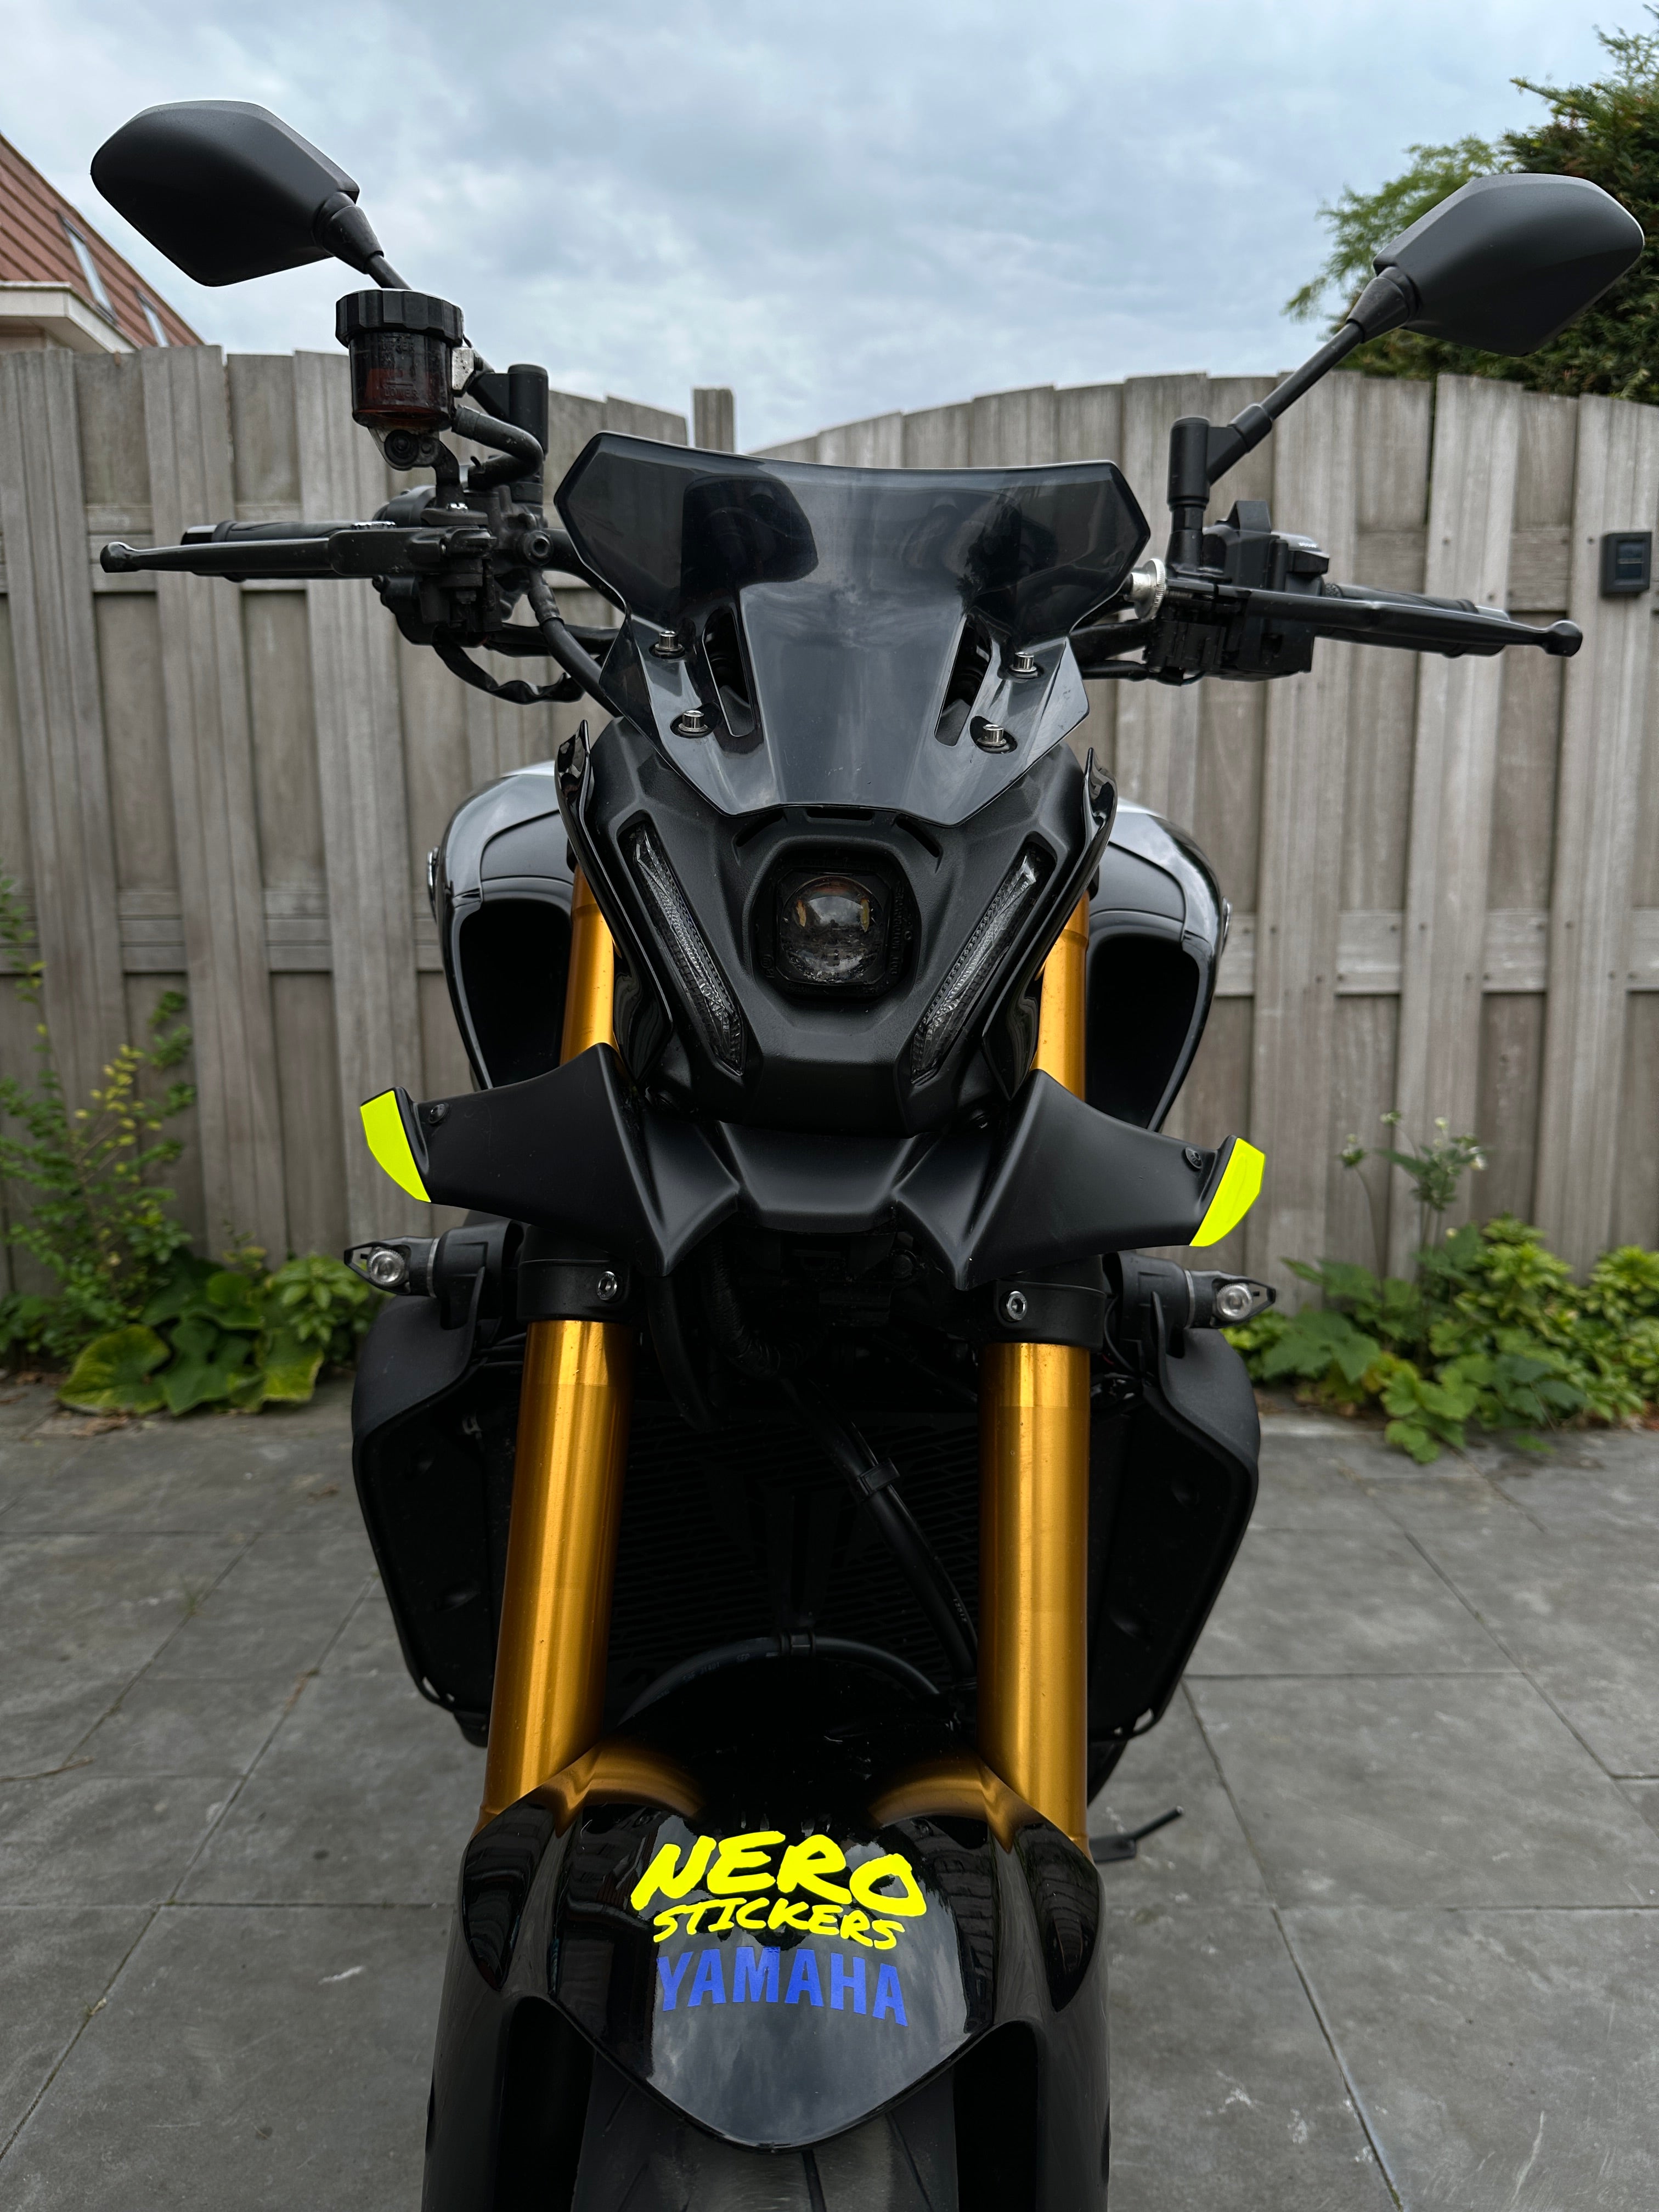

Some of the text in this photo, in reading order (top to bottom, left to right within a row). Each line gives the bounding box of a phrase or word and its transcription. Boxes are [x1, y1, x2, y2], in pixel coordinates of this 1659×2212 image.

[385, 387, 419, 399] LOWER
[630, 1831, 926, 1916] NERO
[653, 1898, 905, 1950] STICKERS
[657, 1946, 908, 2027] YAMAHA
